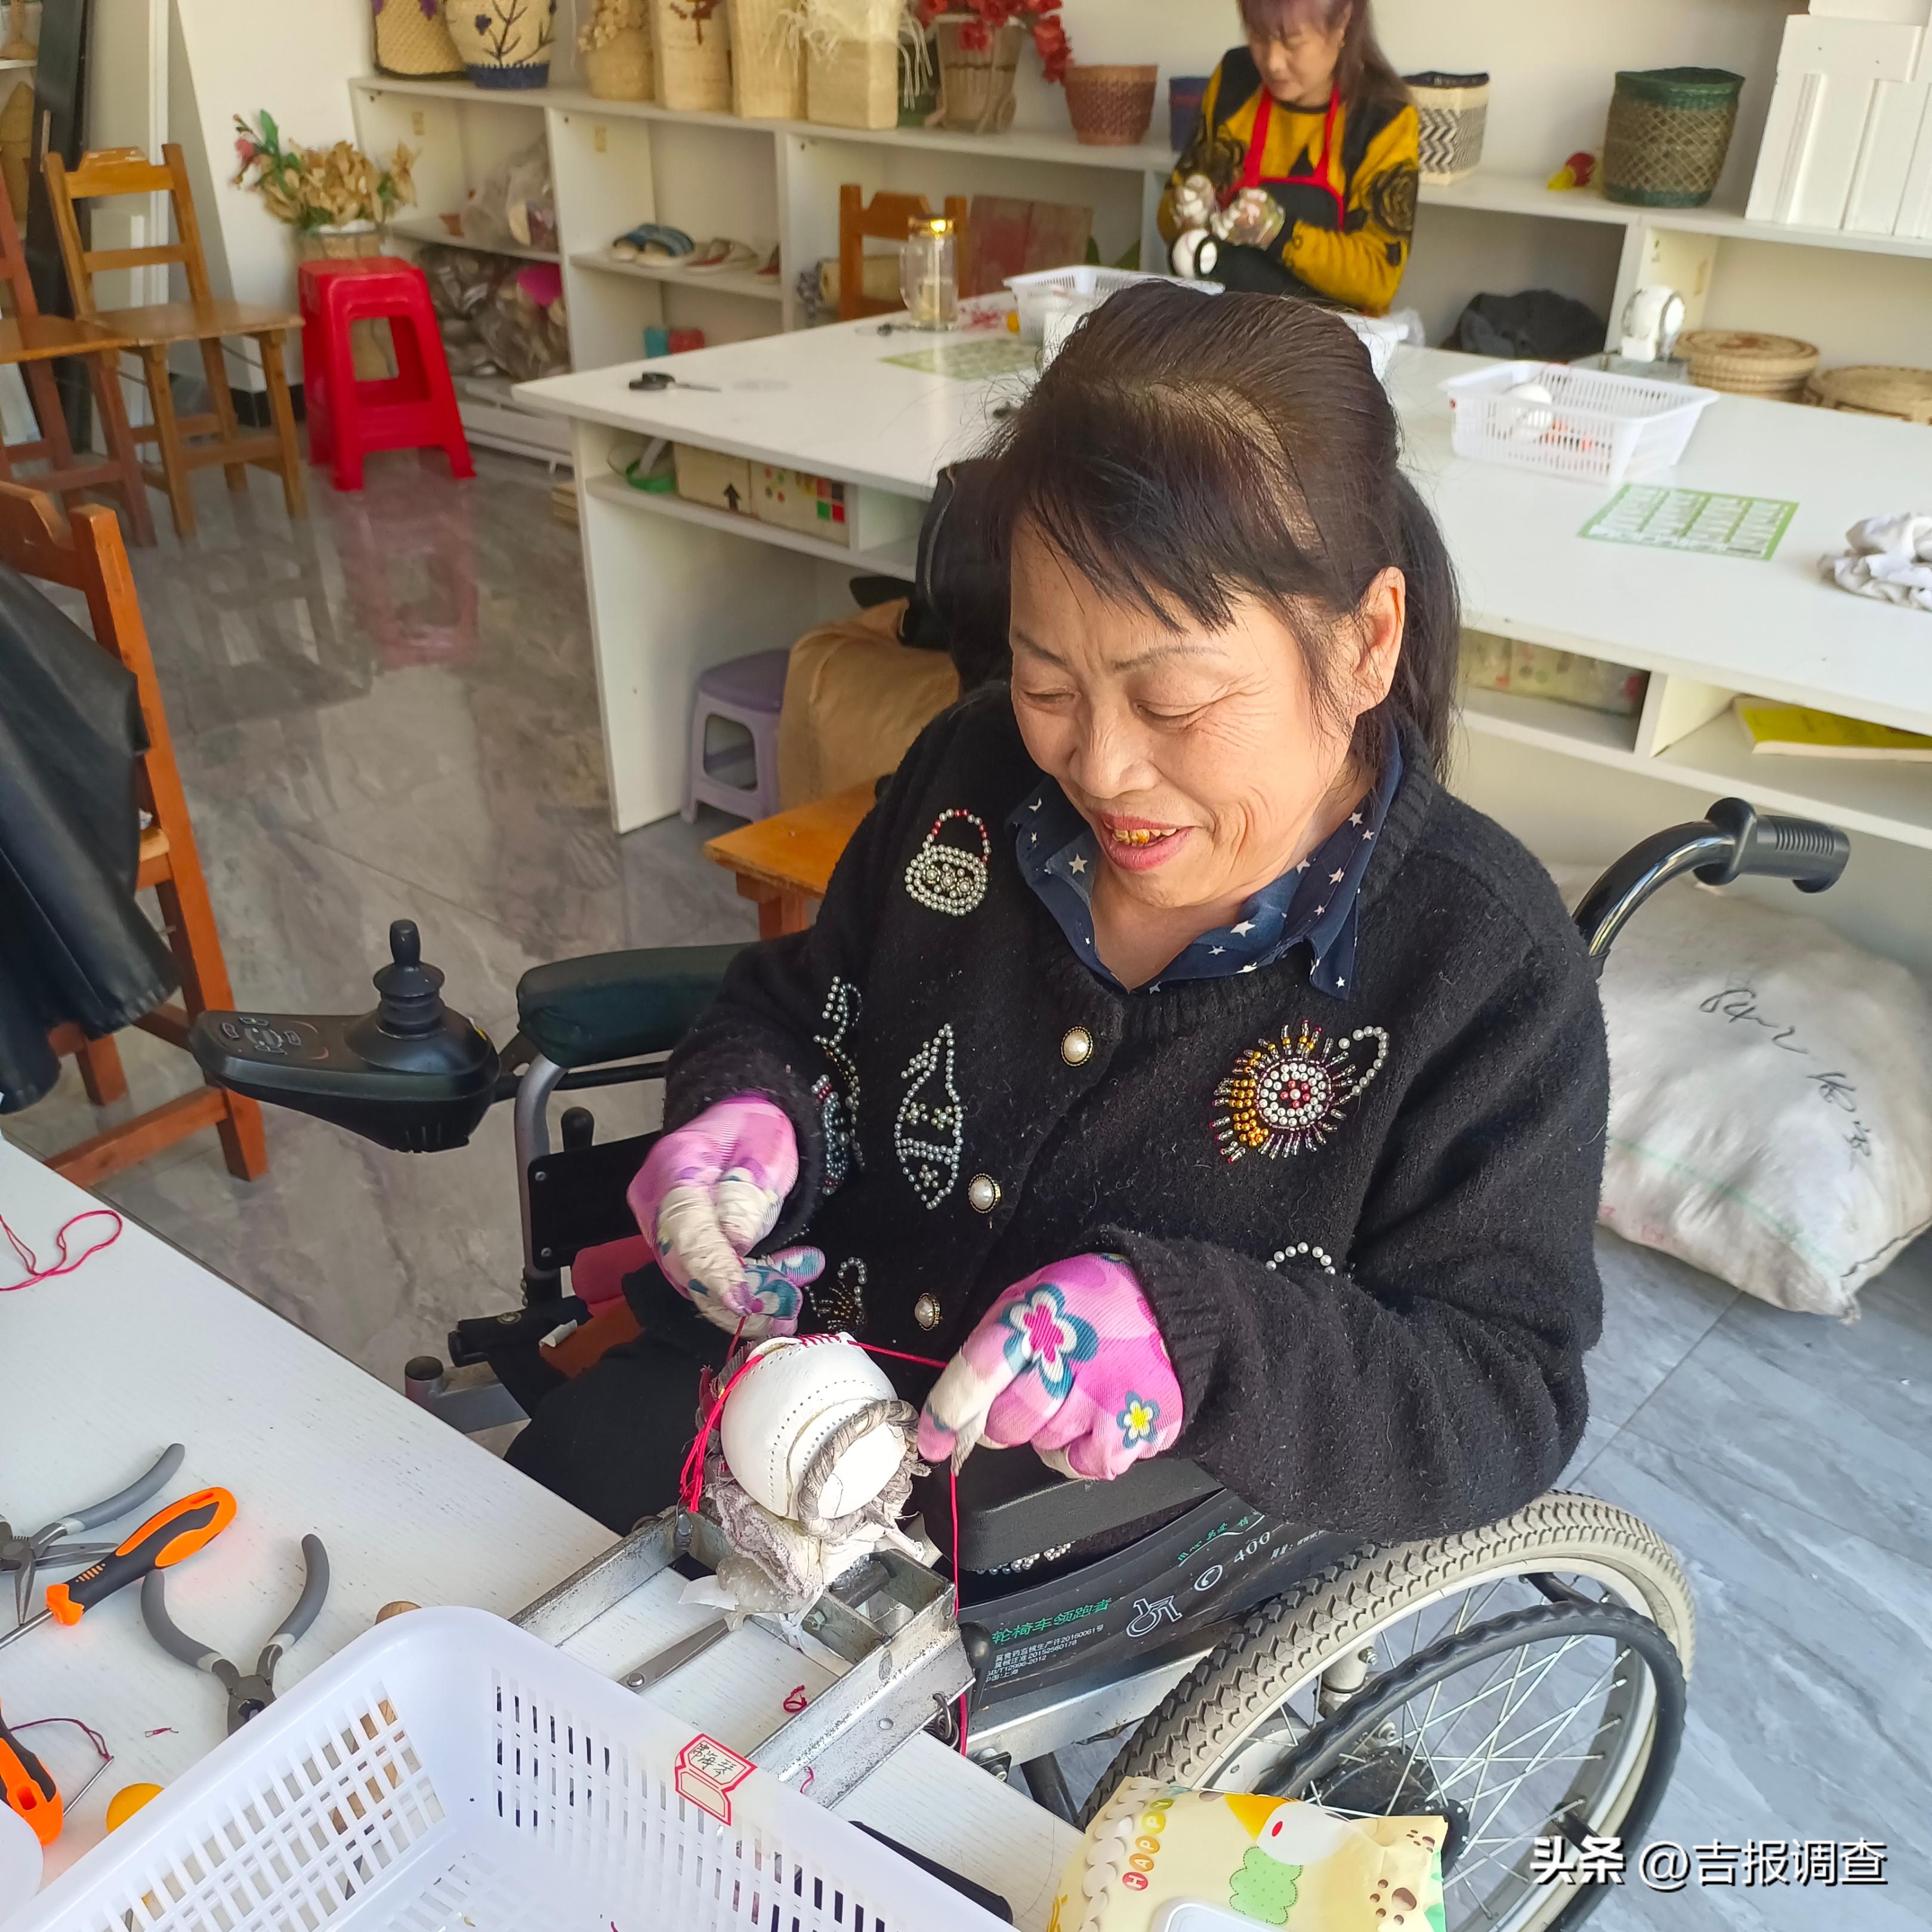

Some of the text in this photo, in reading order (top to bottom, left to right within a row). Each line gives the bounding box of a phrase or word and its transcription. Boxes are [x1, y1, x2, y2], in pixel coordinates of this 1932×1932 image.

[992, 1598, 1112, 1644] 轮椅车领跑者
[1127, 1801, 1169, 1888] HAPPY
